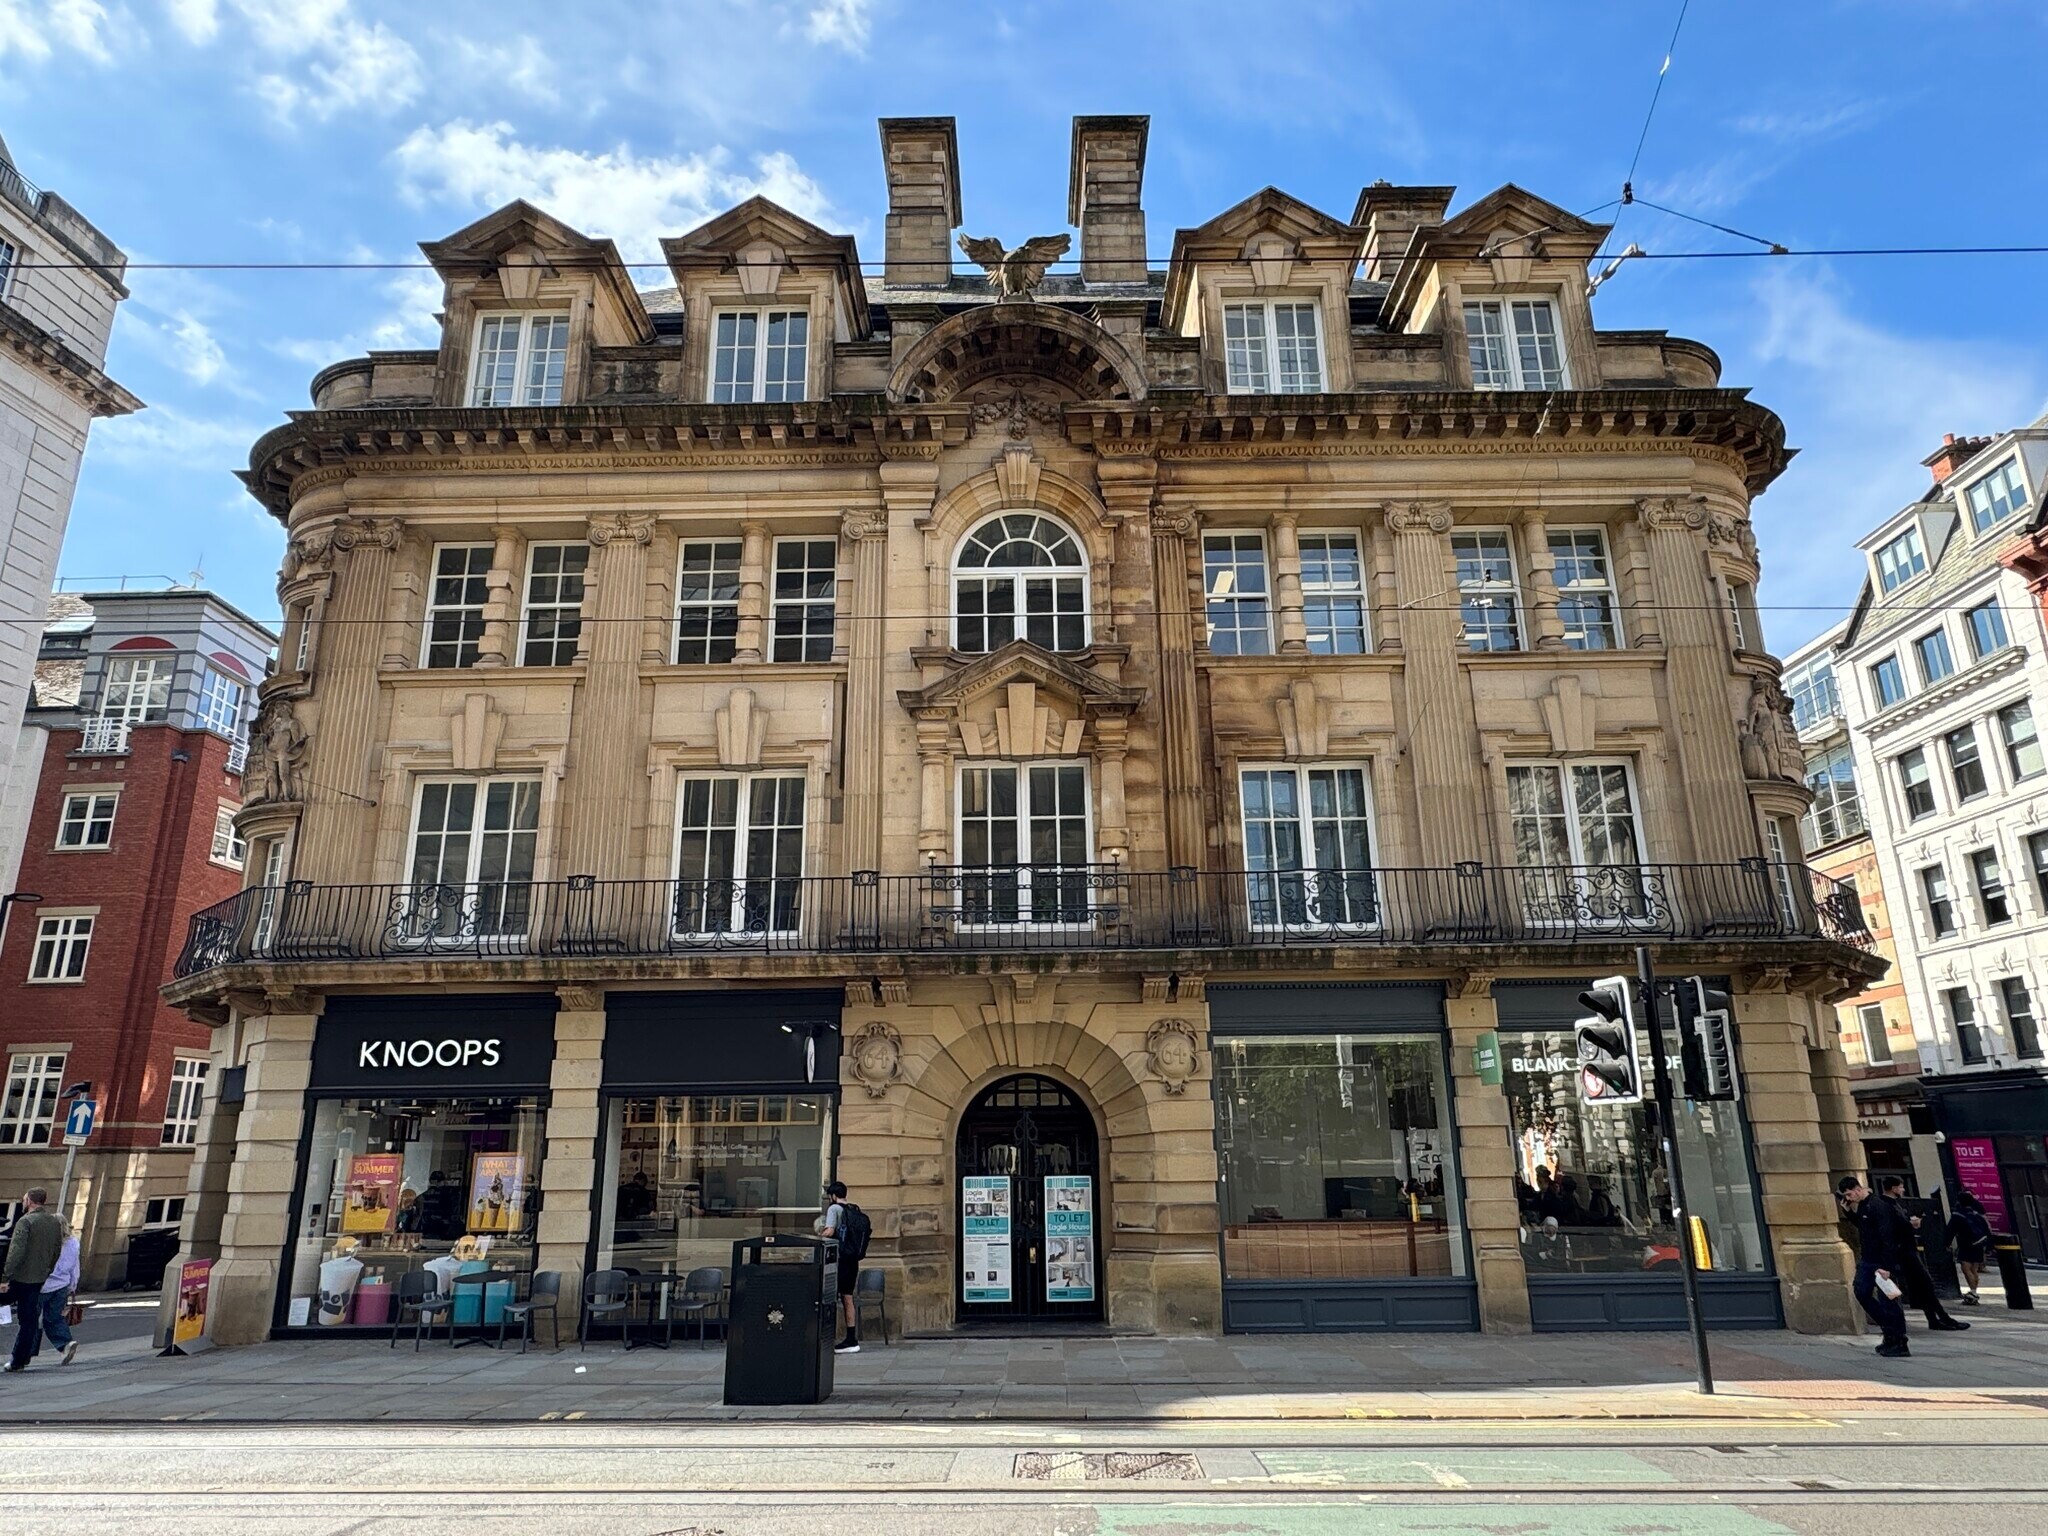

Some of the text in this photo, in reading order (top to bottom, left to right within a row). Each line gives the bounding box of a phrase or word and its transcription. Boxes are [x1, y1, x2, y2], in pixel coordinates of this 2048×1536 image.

[359, 1039, 501, 1068] KNOOPS
[1511, 1057, 1570, 1073] BLANK
[1956, 1146, 1985, 1157] TO LET
[354, 1165, 396, 1175] SUMMER
[974, 1218, 1000, 1226] TO LET
[1054, 1213, 1084, 1223] TO LET
